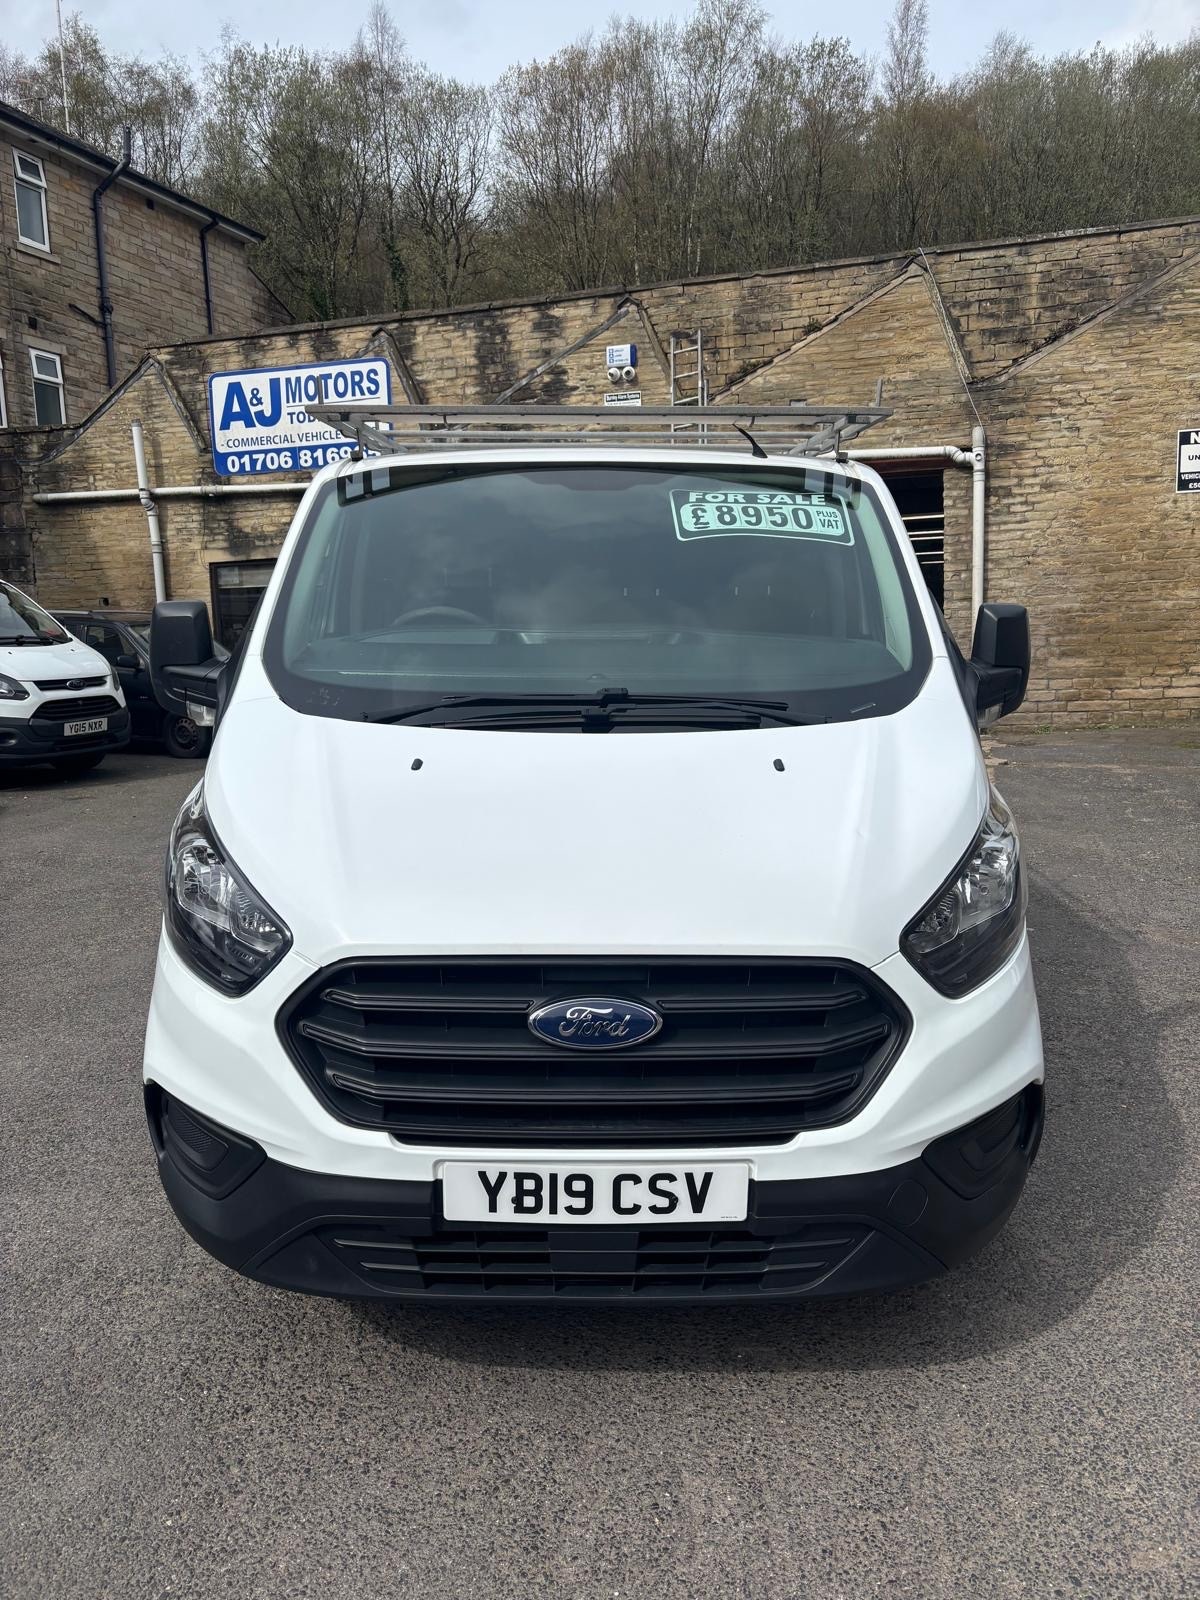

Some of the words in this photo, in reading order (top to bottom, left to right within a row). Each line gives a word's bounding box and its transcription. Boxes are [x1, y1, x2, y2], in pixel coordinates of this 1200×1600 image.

[219, 377, 282, 431] A&J
[285, 368, 380, 403] MOTORS
[226, 434, 296, 449] COMMERCIAL
[227, 451, 293, 473] 01706
[688, 492, 746, 503] FOR
[757, 493, 826, 506] SALE
[690, 503, 814, 530] £8950
[816, 510, 839, 519] PLUS
[818, 519, 840, 530] VAT
[69, 722, 87, 734] YG15
[88, 720, 103, 731] NXR
[559, 1006, 631, 1037] Ford
[477, 1171, 594, 1215] YB19
[612, 1172, 714, 1216] CSV
